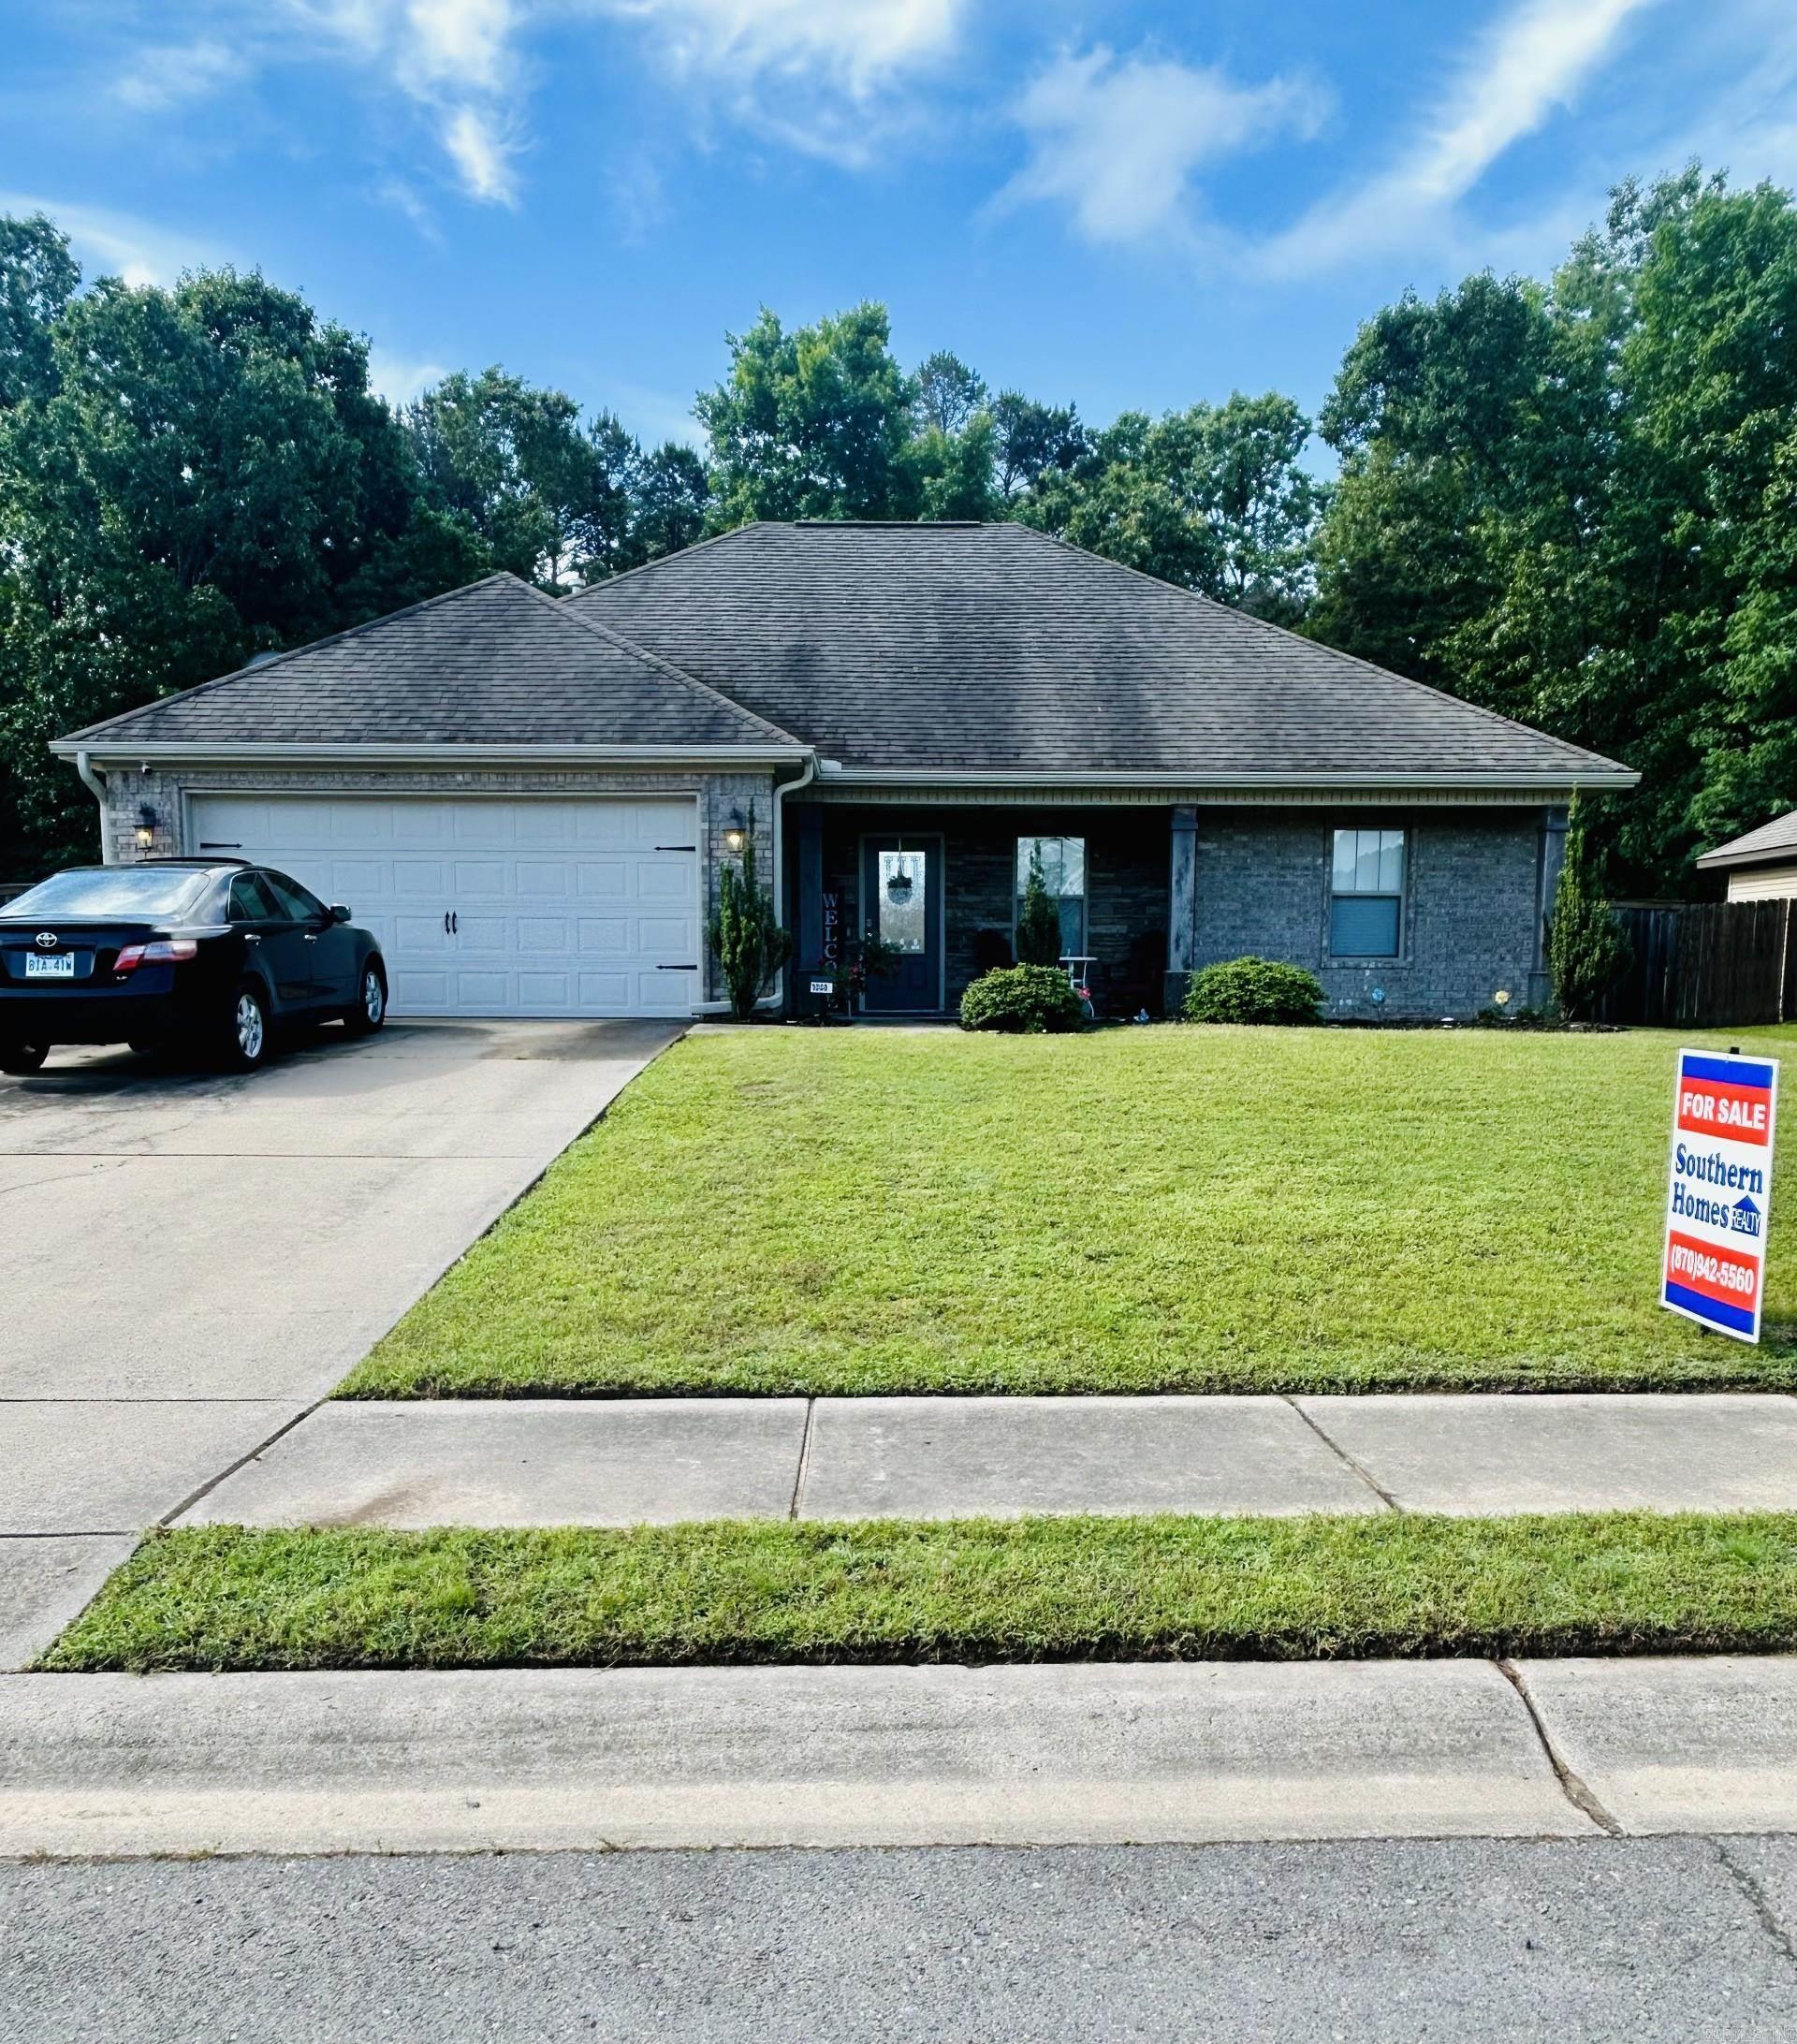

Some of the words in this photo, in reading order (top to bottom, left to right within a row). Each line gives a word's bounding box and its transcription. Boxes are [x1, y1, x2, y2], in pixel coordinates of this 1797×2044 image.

[822, 892, 840, 1009] WELCO
[1682, 1091, 1716, 1122] FOR
[1717, 1098, 1767, 1131] SALE
[1675, 1142, 1763, 1194] Southern
[1672, 1181, 1730, 1229] Homes
[1731, 1207, 1760, 1235] REALTY
[1671, 1243, 1755, 1295] (870)942-5560
